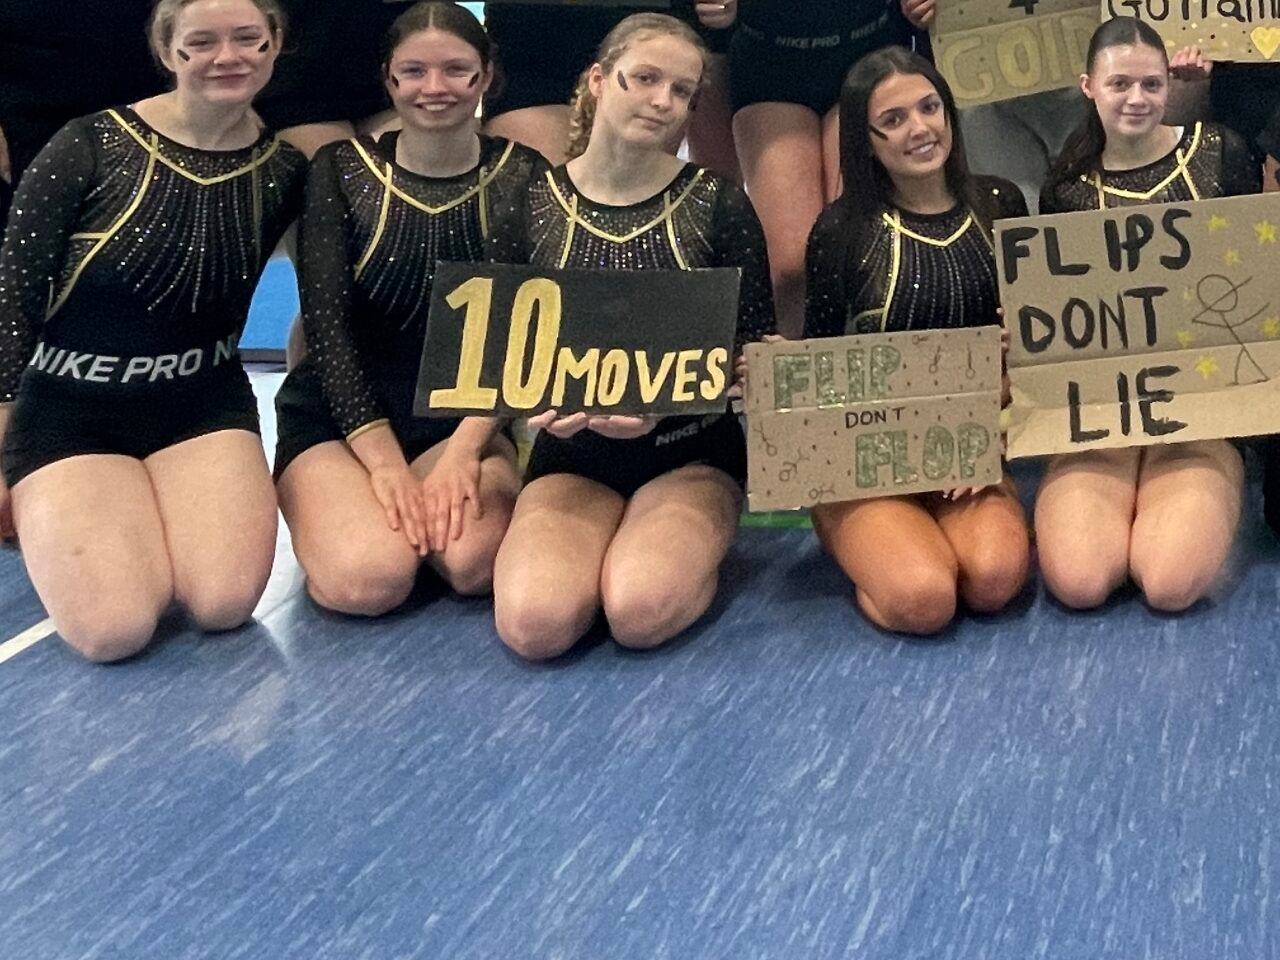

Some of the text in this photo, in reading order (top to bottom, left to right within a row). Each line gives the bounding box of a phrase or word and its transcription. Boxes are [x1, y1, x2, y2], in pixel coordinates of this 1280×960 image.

[1001, 208, 1193, 286] FLIPS
[428, 276, 729, 411] 10 MOVES
[1018, 286, 1169, 354] DONT
[29, 341, 120, 382] NIKE
[120, 348, 204, 384] PRO
[772, 344, 902, 414] FLIP
[844, 406, 906, 430] DON'T
[1067, 365, 1190, 444] LIE
[855, 421, 990, 489] FLOP
